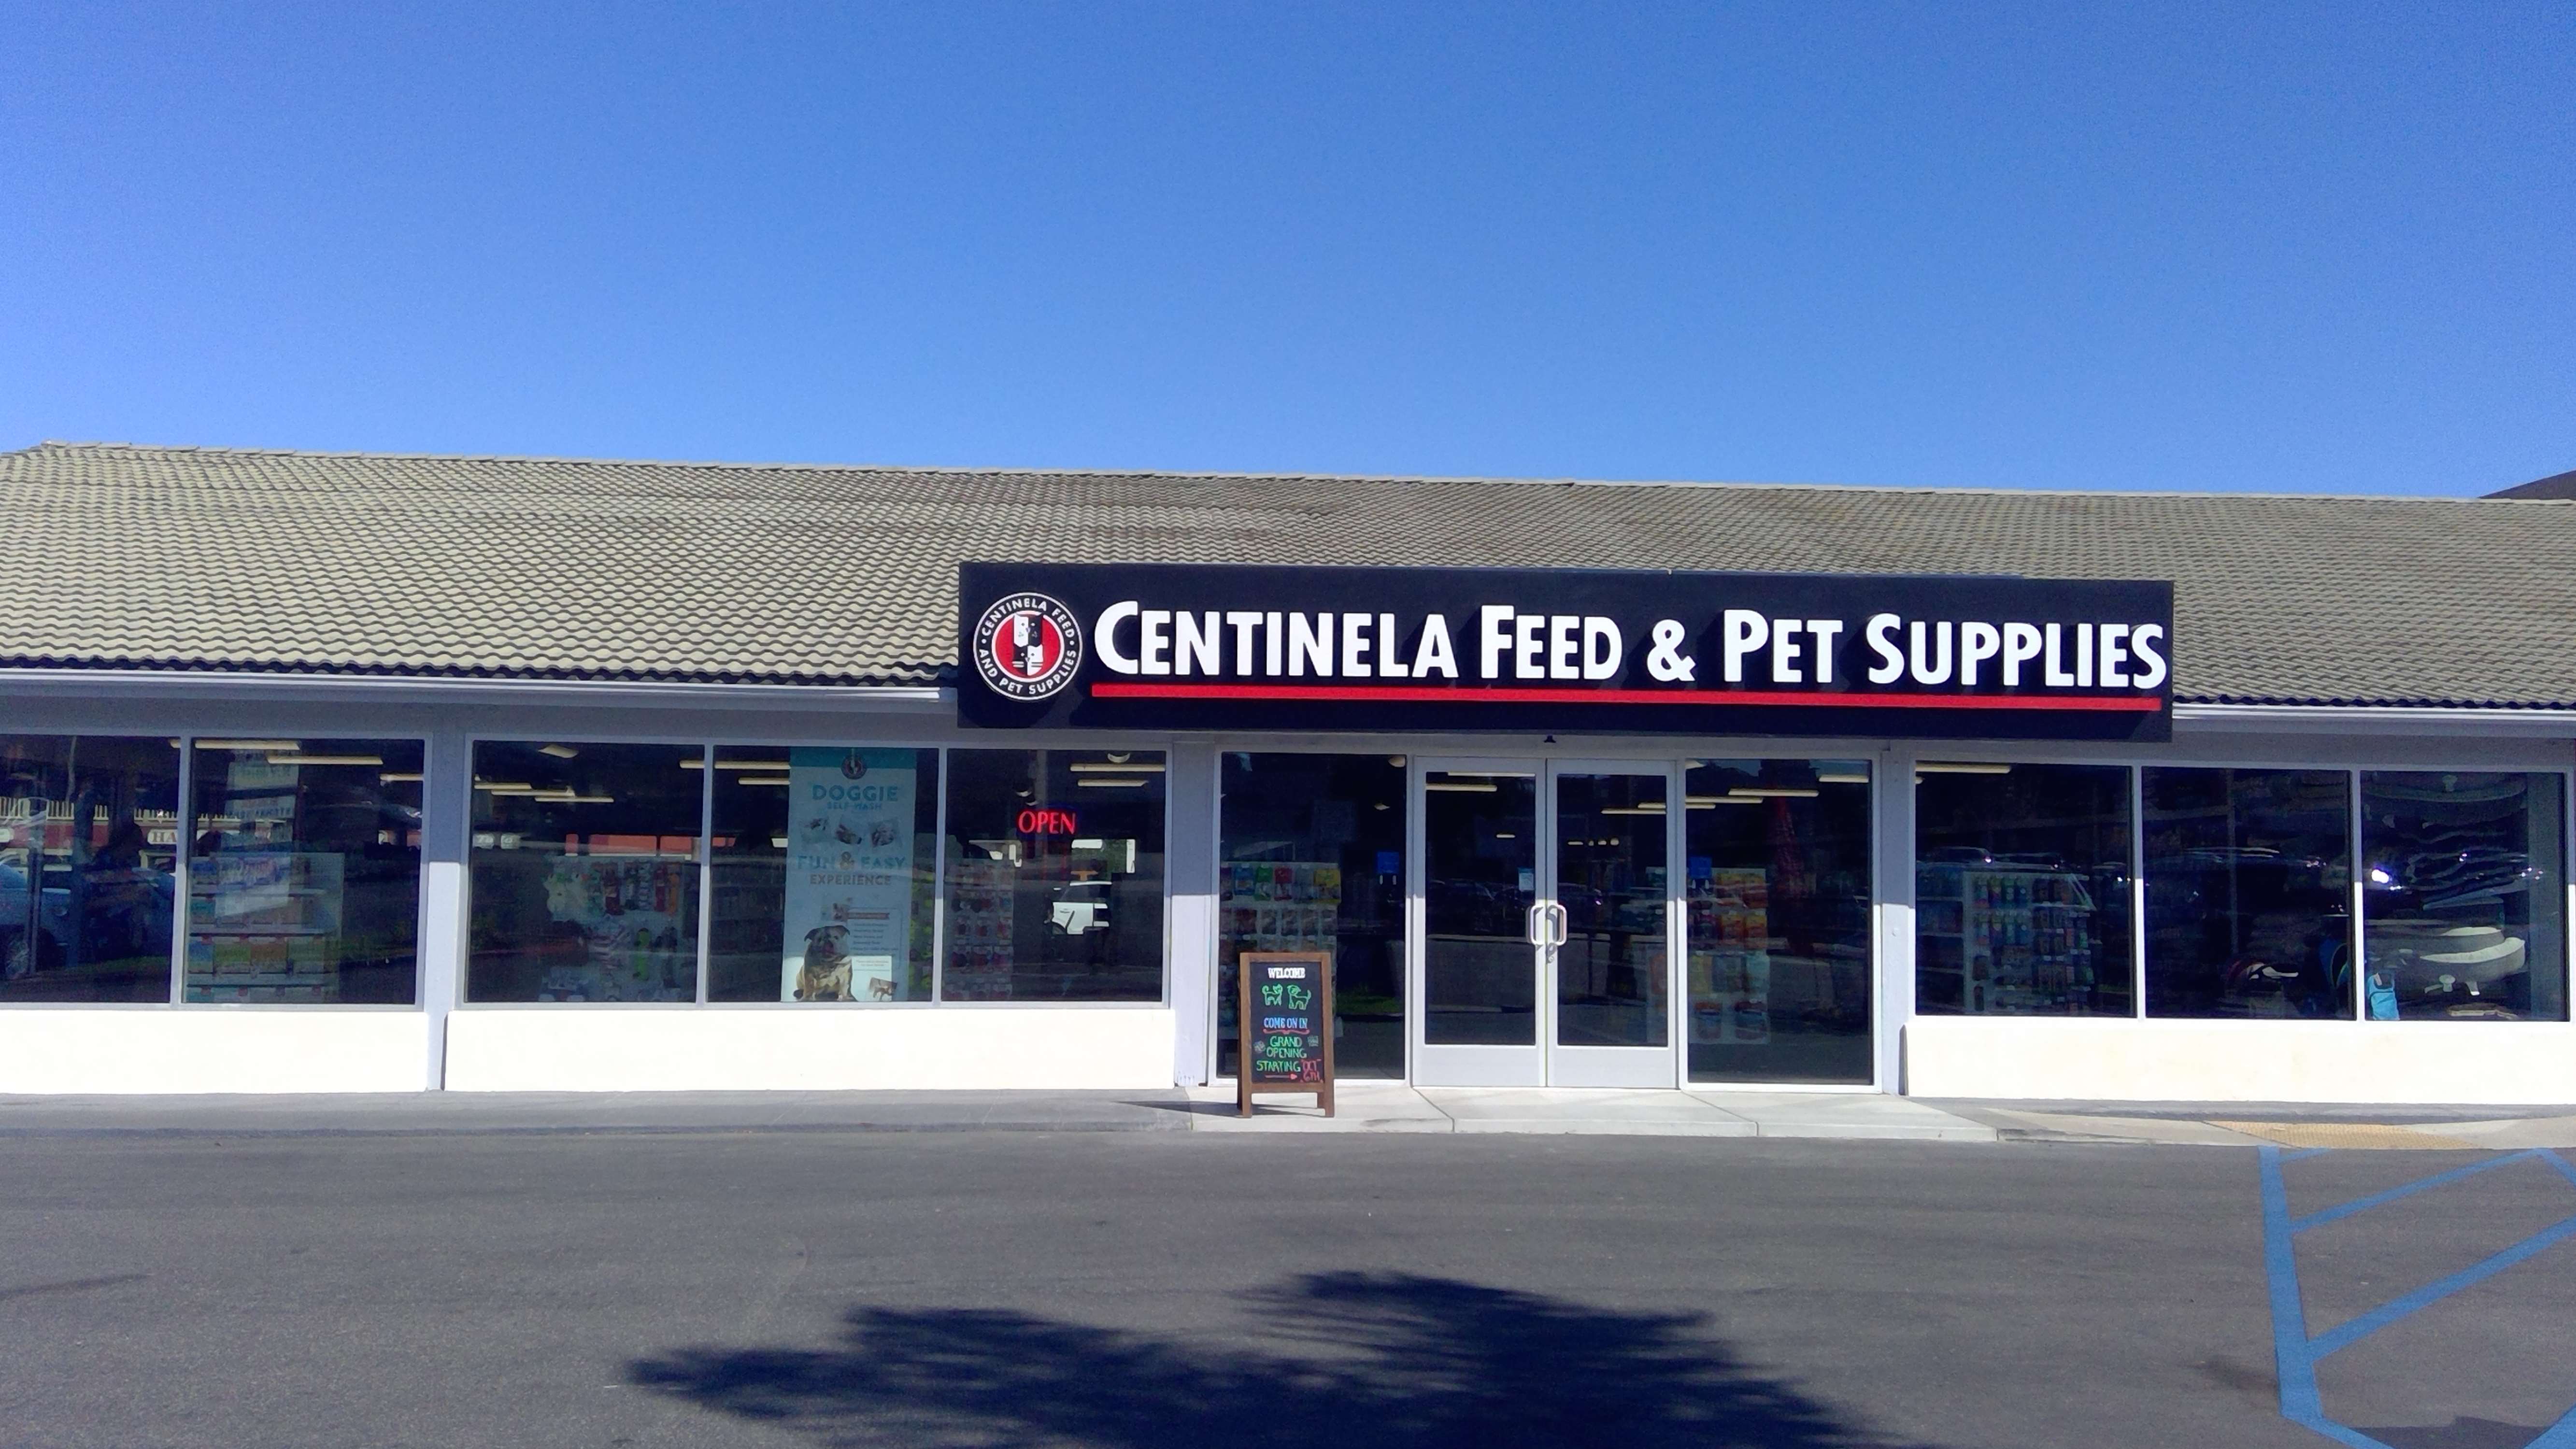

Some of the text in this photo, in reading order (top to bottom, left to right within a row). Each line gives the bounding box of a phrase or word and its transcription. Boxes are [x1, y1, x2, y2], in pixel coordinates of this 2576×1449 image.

[982, 598, 1075, 638] CENTINELA FEED
[1095, 601, 2166, 689] CENTINELA FEED & PET SUPPLIES
[979, 649, 1077, 695] AND PET SUPPLIES
[811, 784, 899, 802] DOGGIE
[1018, 810, 1076, 835] OPEN
[840, 851, 855, 869] &
[861, 856, 906, 870] EASY
[809, 874, 892, 885] EXPERIENCE
[1267, 967, 1306, 979] WELCOME
[1263, 1017, 1308, 1029] COME ON IN
[1269, 1036, 1303, 1048] GRAND
[1266, 1046, 1307, 1059] OPENING
[1256, 1060, 1301, 1073] STARTING
